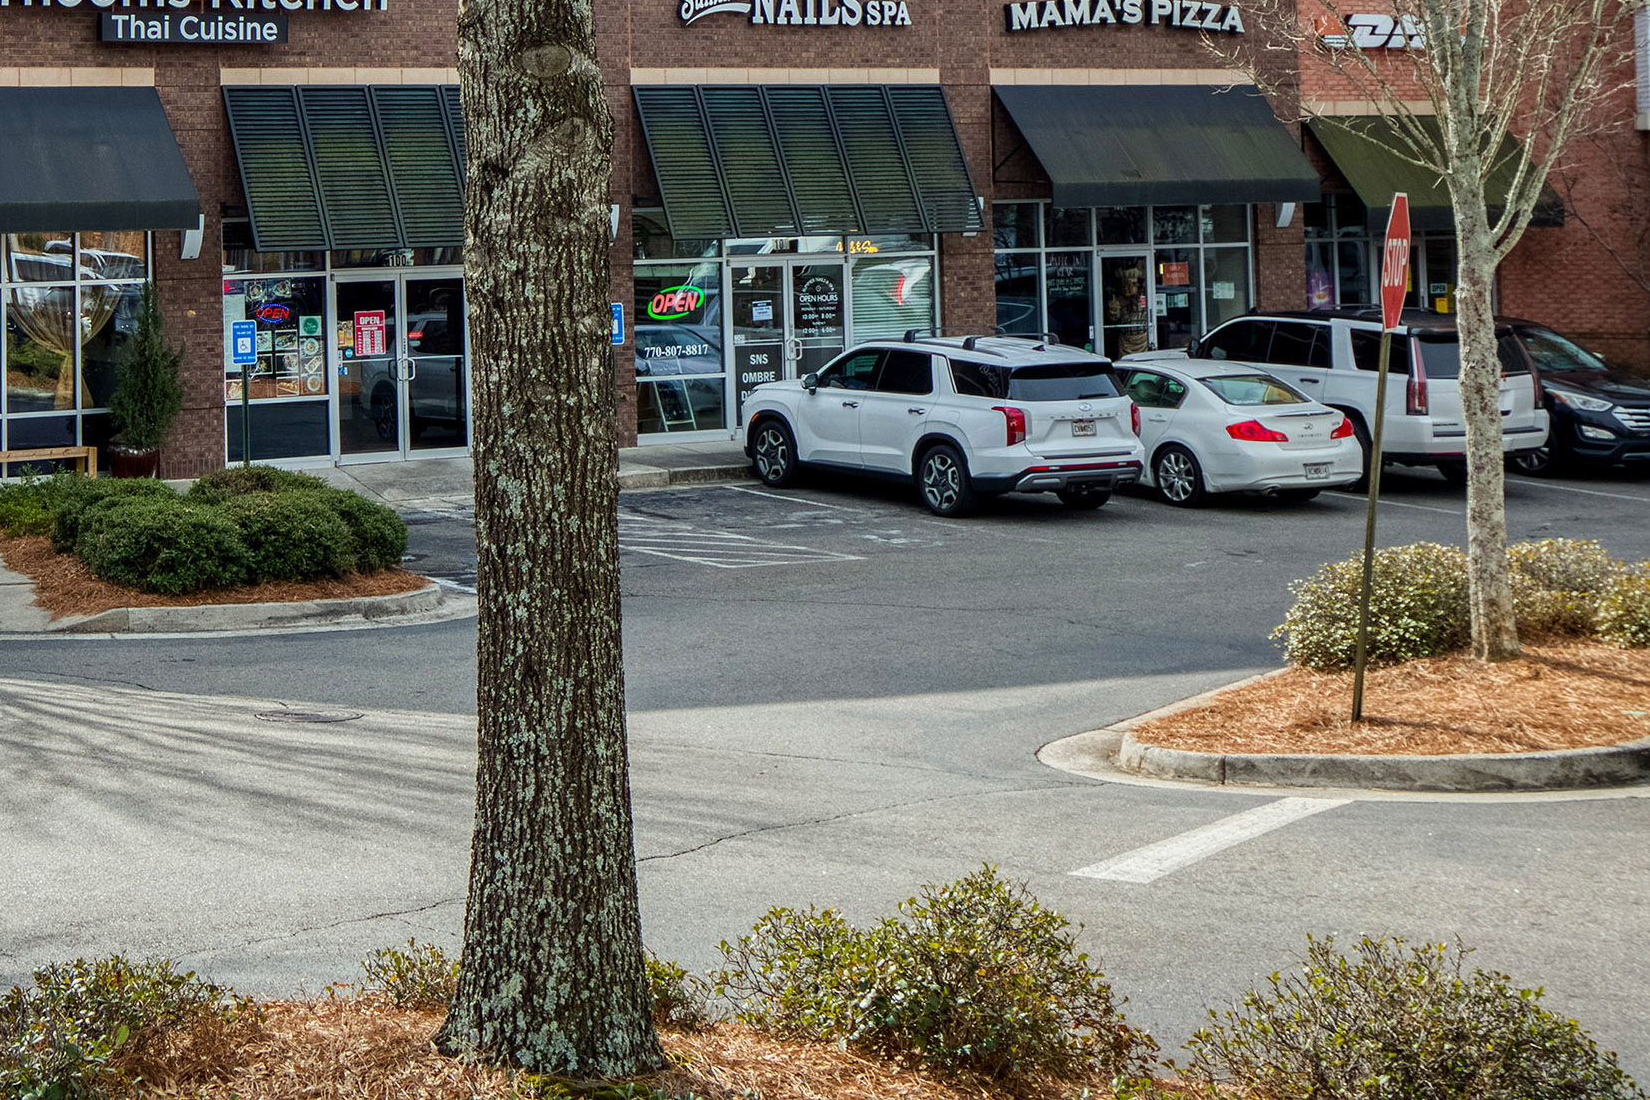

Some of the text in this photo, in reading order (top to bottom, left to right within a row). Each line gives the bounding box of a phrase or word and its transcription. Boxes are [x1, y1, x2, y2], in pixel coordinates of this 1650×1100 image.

[866, 0, 912, 26] SPA
[111, 14, 278, 42] Thai Cuisine
[1384, 238, 1408, 288] STOP
[652, 292, 698, 314] OPEN
[799, 294, 839, 303] OPEN HOURS
[255, 307, 290, 319] OPEN
[359, 316, 380, 325] OPEN
[645, 344, 708, 358] 770-807-8817
[750, 353, 769, 365] SNS
[742, 371, 776, 383] OMBRE
